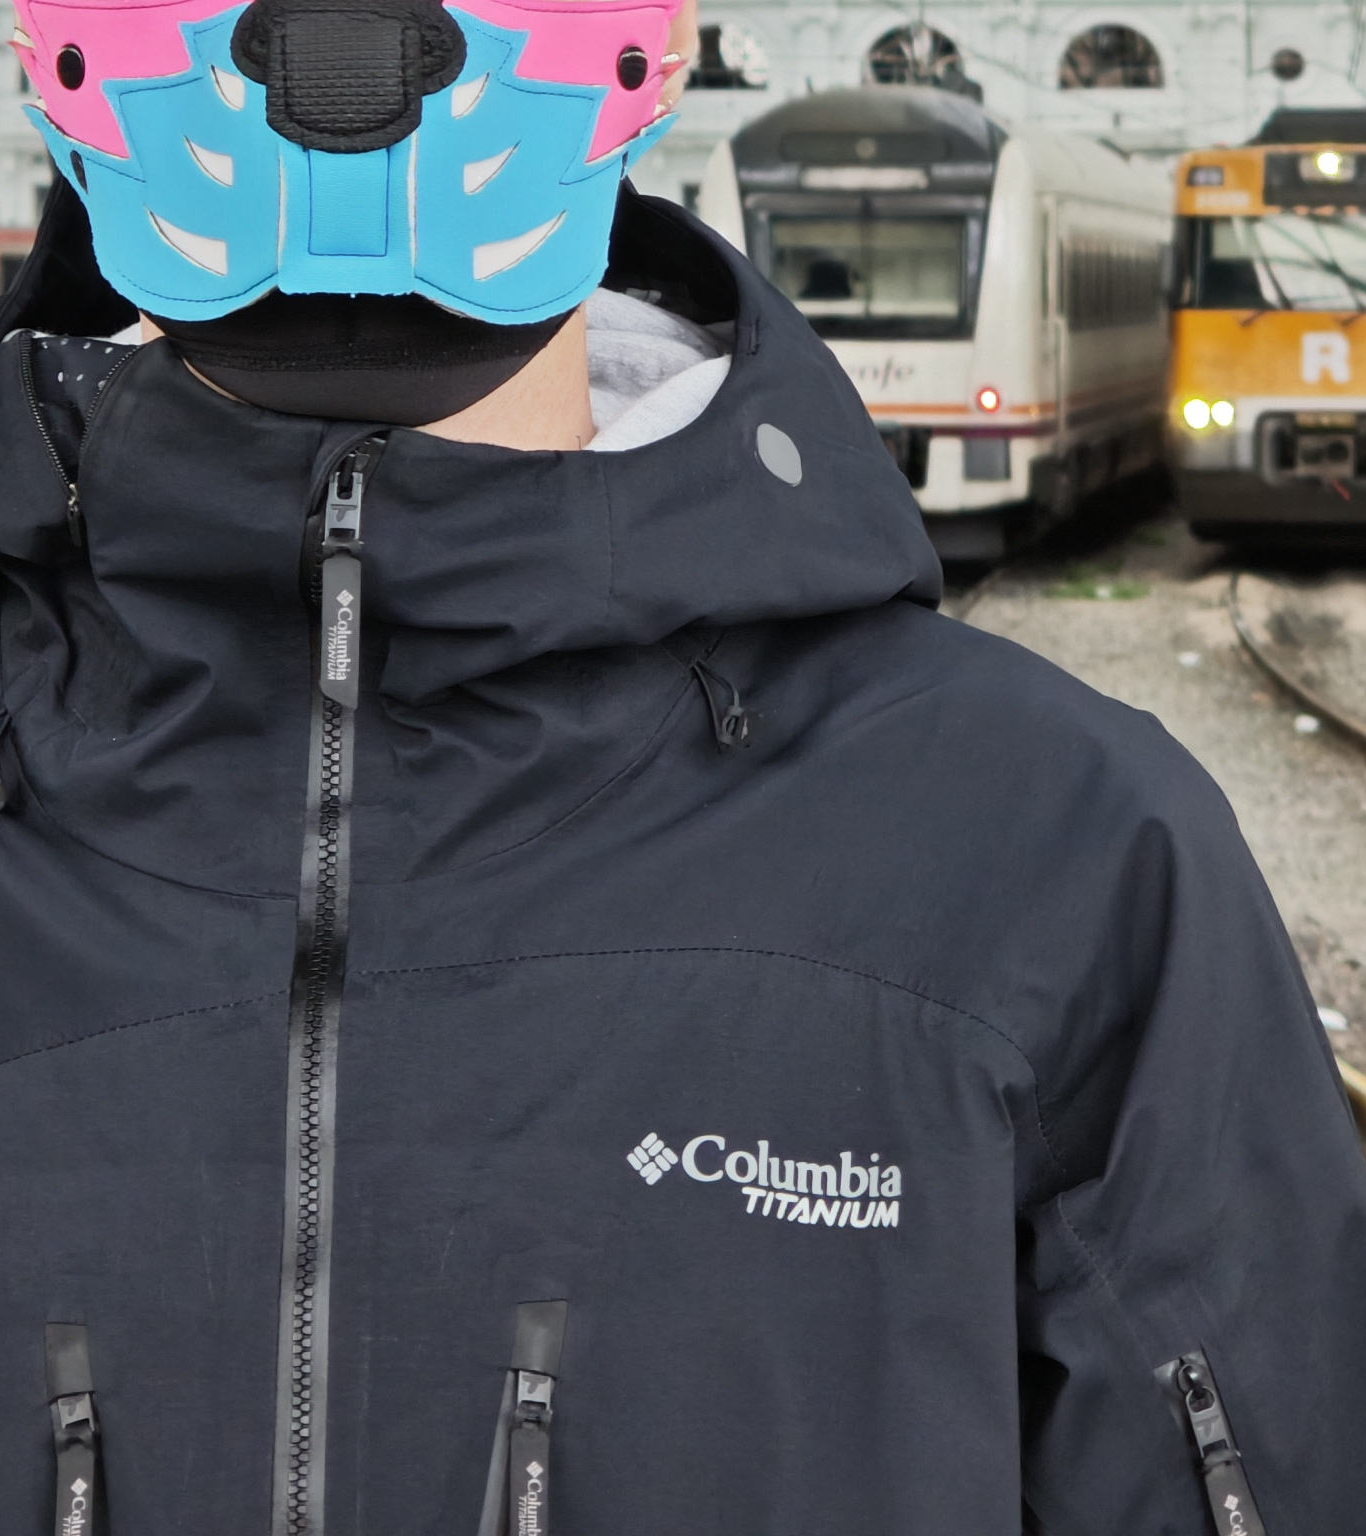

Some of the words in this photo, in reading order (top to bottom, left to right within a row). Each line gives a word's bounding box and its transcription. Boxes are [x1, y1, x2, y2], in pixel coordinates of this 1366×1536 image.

[849, 356, 915, 390] nfe
[1301, 331, 1351, 384] R
[327, 625, 337, 681] TITANIUM
[336, 607, 353, 681] Columbia
[681, 1134, 903, 1199] Columbia
[741, 1186, 900, 1229] TITANIUM
[71, 1496, 86, 1536] Colu
